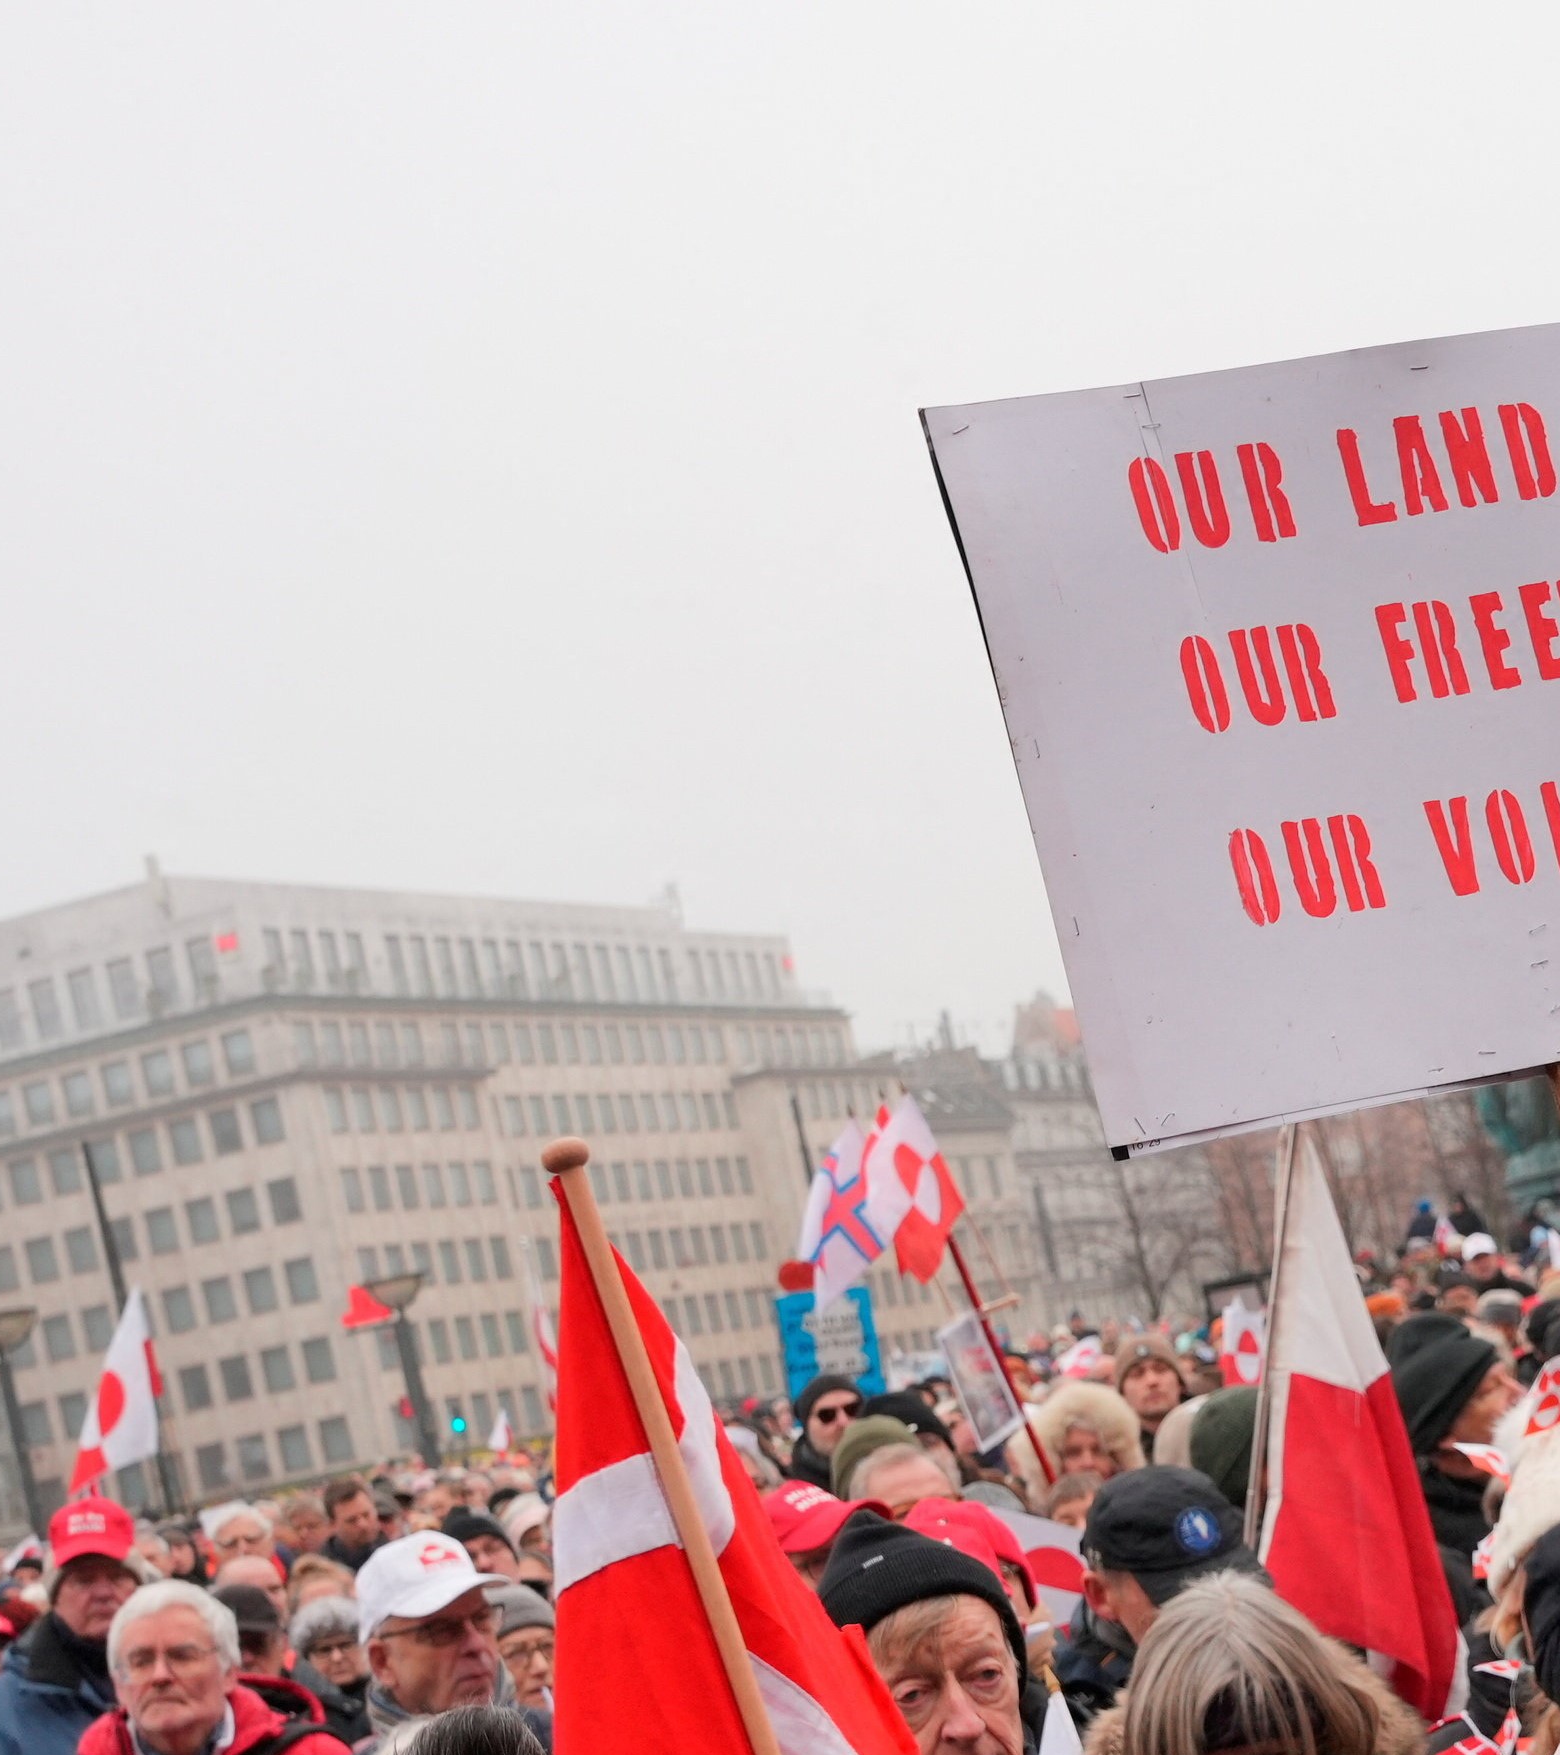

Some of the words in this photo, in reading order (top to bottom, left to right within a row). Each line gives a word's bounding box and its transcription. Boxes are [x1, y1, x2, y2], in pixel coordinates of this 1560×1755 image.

[1127, 441, 1297, 554] OUR
[1336, 402, 1560, 527] LAND
[1179, 620, 1337, 734] OUR
[1227, 812, 1386, 927] OUR
